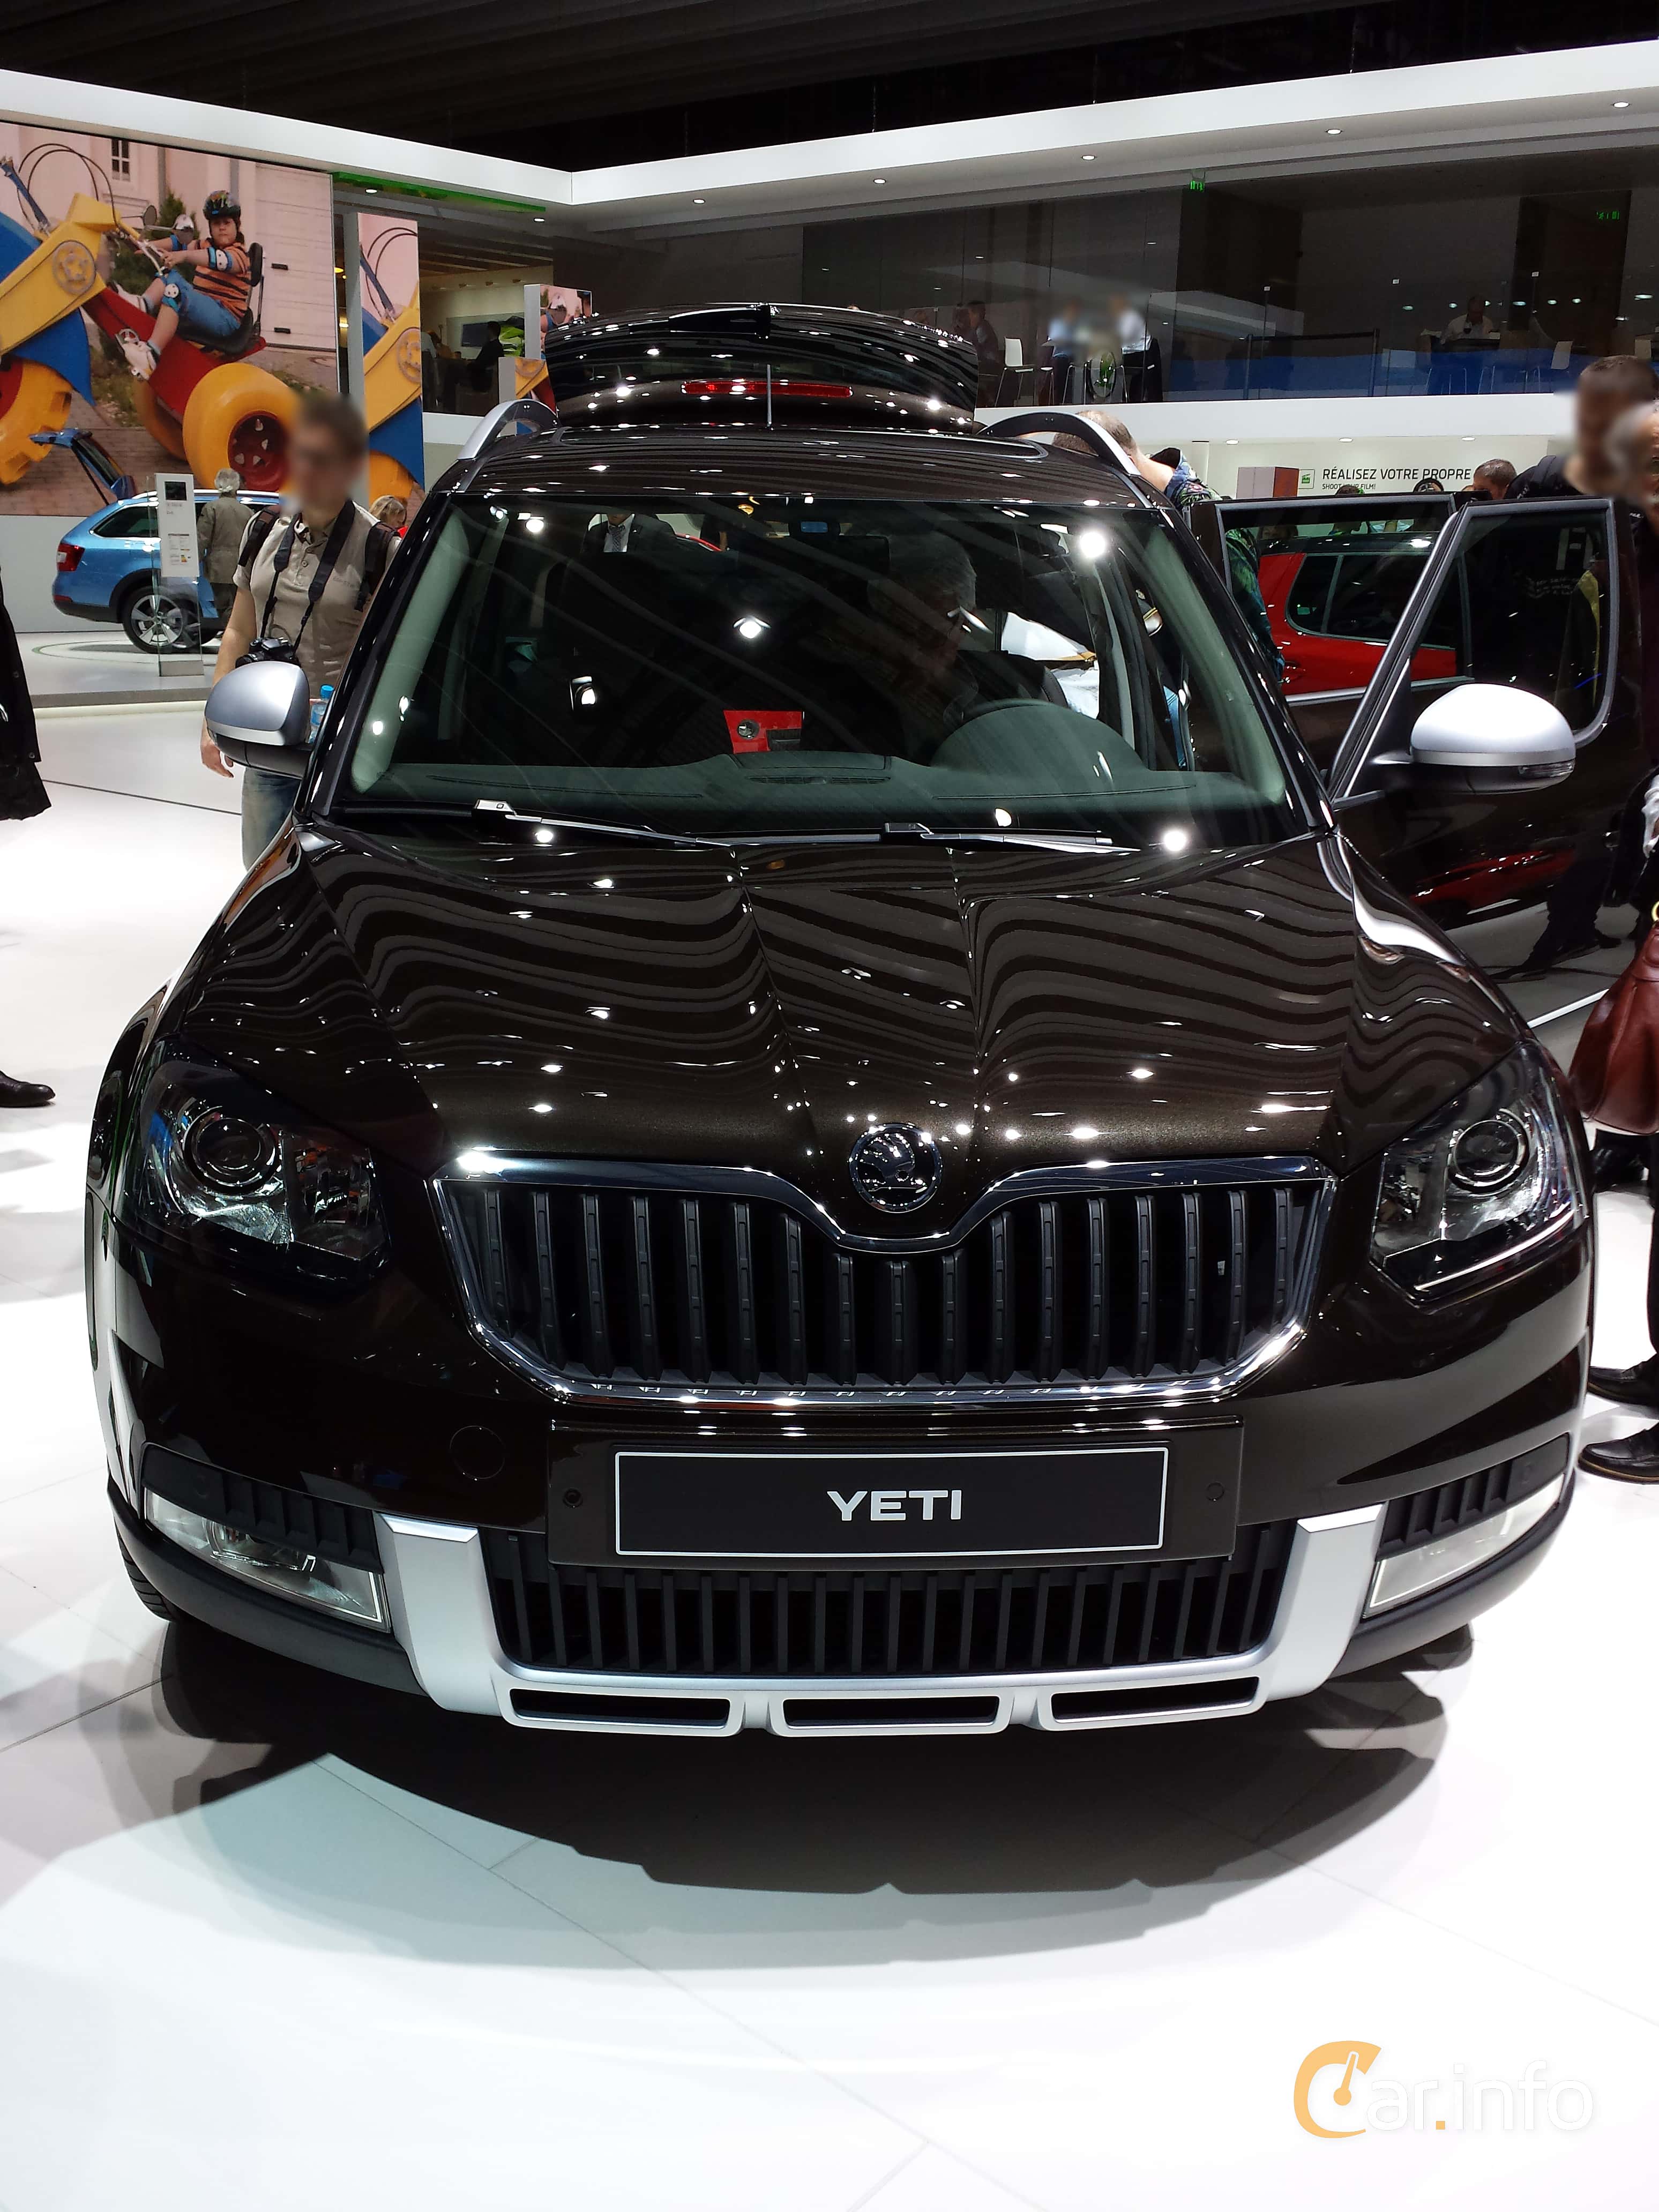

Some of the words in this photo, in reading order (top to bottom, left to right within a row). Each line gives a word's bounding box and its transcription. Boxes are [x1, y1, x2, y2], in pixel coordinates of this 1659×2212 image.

[1322, 466, 1377, 480] RÉALISEZ
[1380, 468, 1419, 480] VOTRE
[1423, 468, 1471, 480] PROPRE
[826, 1490, 962, 1521] YETI
